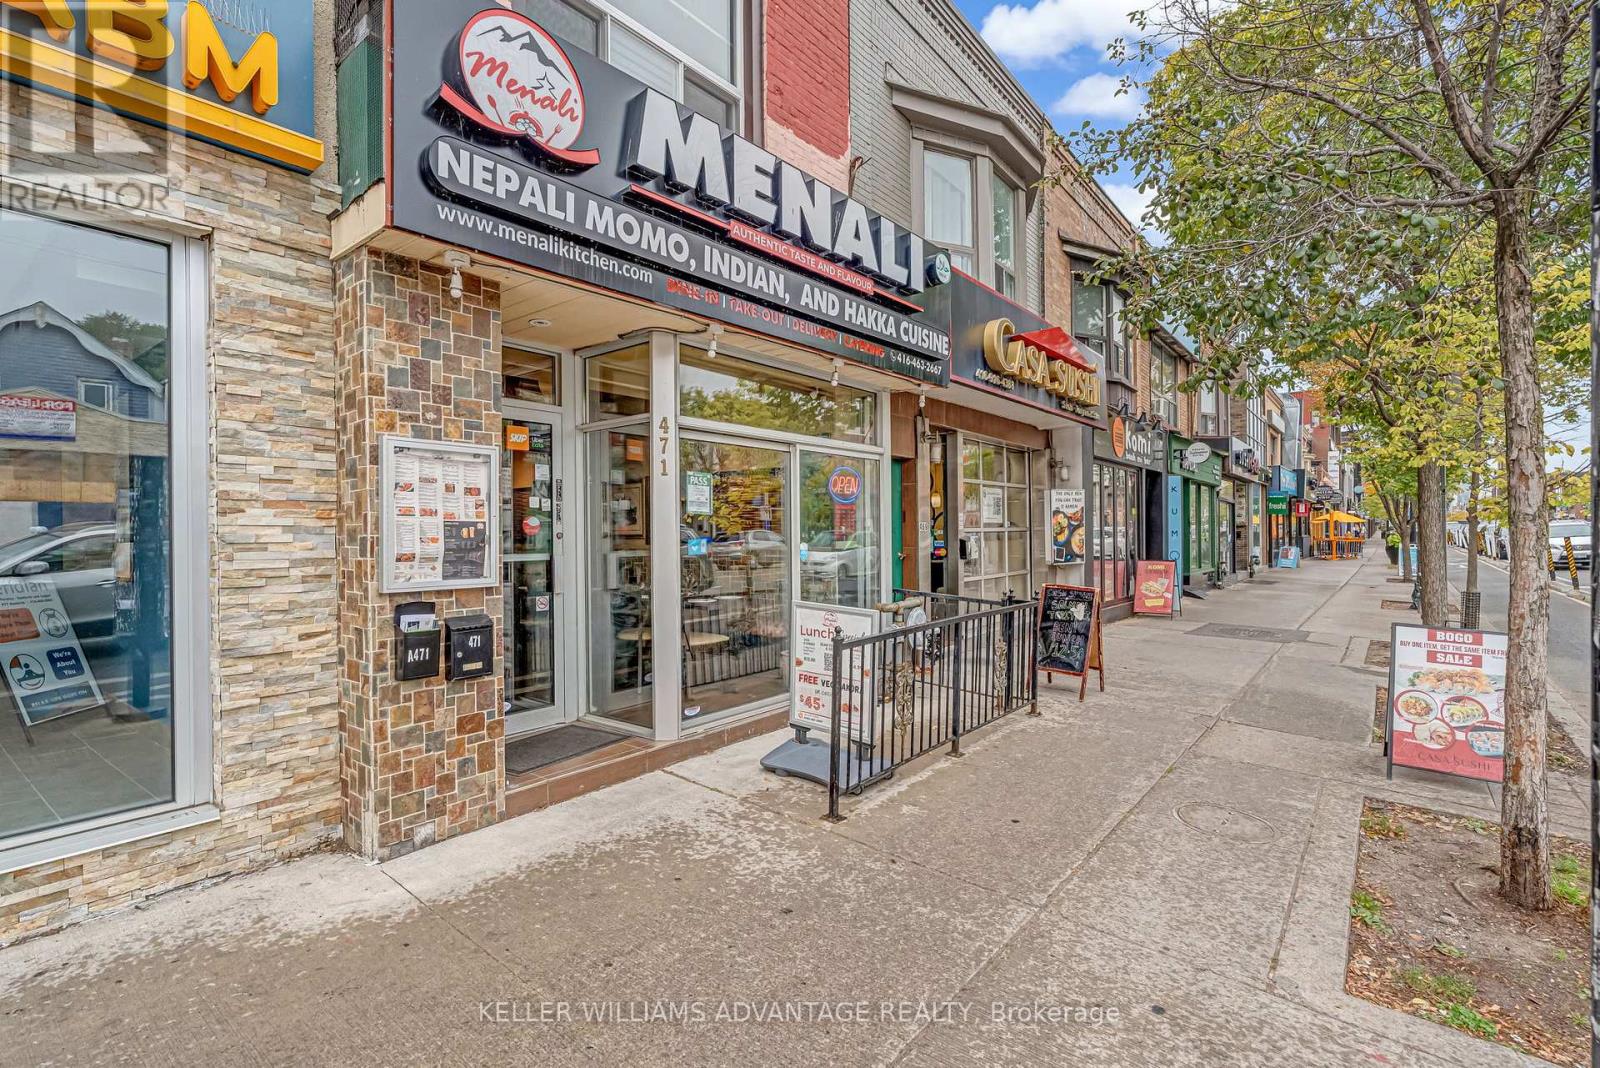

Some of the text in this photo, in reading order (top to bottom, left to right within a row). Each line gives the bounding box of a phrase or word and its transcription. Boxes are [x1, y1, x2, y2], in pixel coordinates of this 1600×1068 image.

[465, 52, 579, 122] Menali
[630, 88, 924, 293] MENALI
[437, 203, 654, 284] www.menalikitchen.com
[437, 140, 949, 355] NEPALI MOMO, INDIAN, AND HAKKA CUISINE
[732, 224, 873, 292] AUTHENTIC TASTE AND FLAVOUR
[729, 296, 785, 327] TAKE-OUT
[791, 318, 838, 343] DELIVERY
[896, 353, 943, 376] 416-463-2667
[984, 318, 1051, 388] CASA
[1052, 359, 1101, 407] SUSHI
[658, 416, 670, 477] 471
[690, 476, 708, 486] PASS
[831, 475, 859, 494] OPEN
[468, 635, 481, 648] 471
[800, 624, 835, 640] Lunch
[1436, 631, 1473, 643] BOGO
[407, 647, 430, 663] A471
[1412, 641, 1423, 649] ONE
[1464, 647, 1481, 655] SAME
[1436, 653, 1473, 666] SALE
[798, 673, 819, 686] FREE
